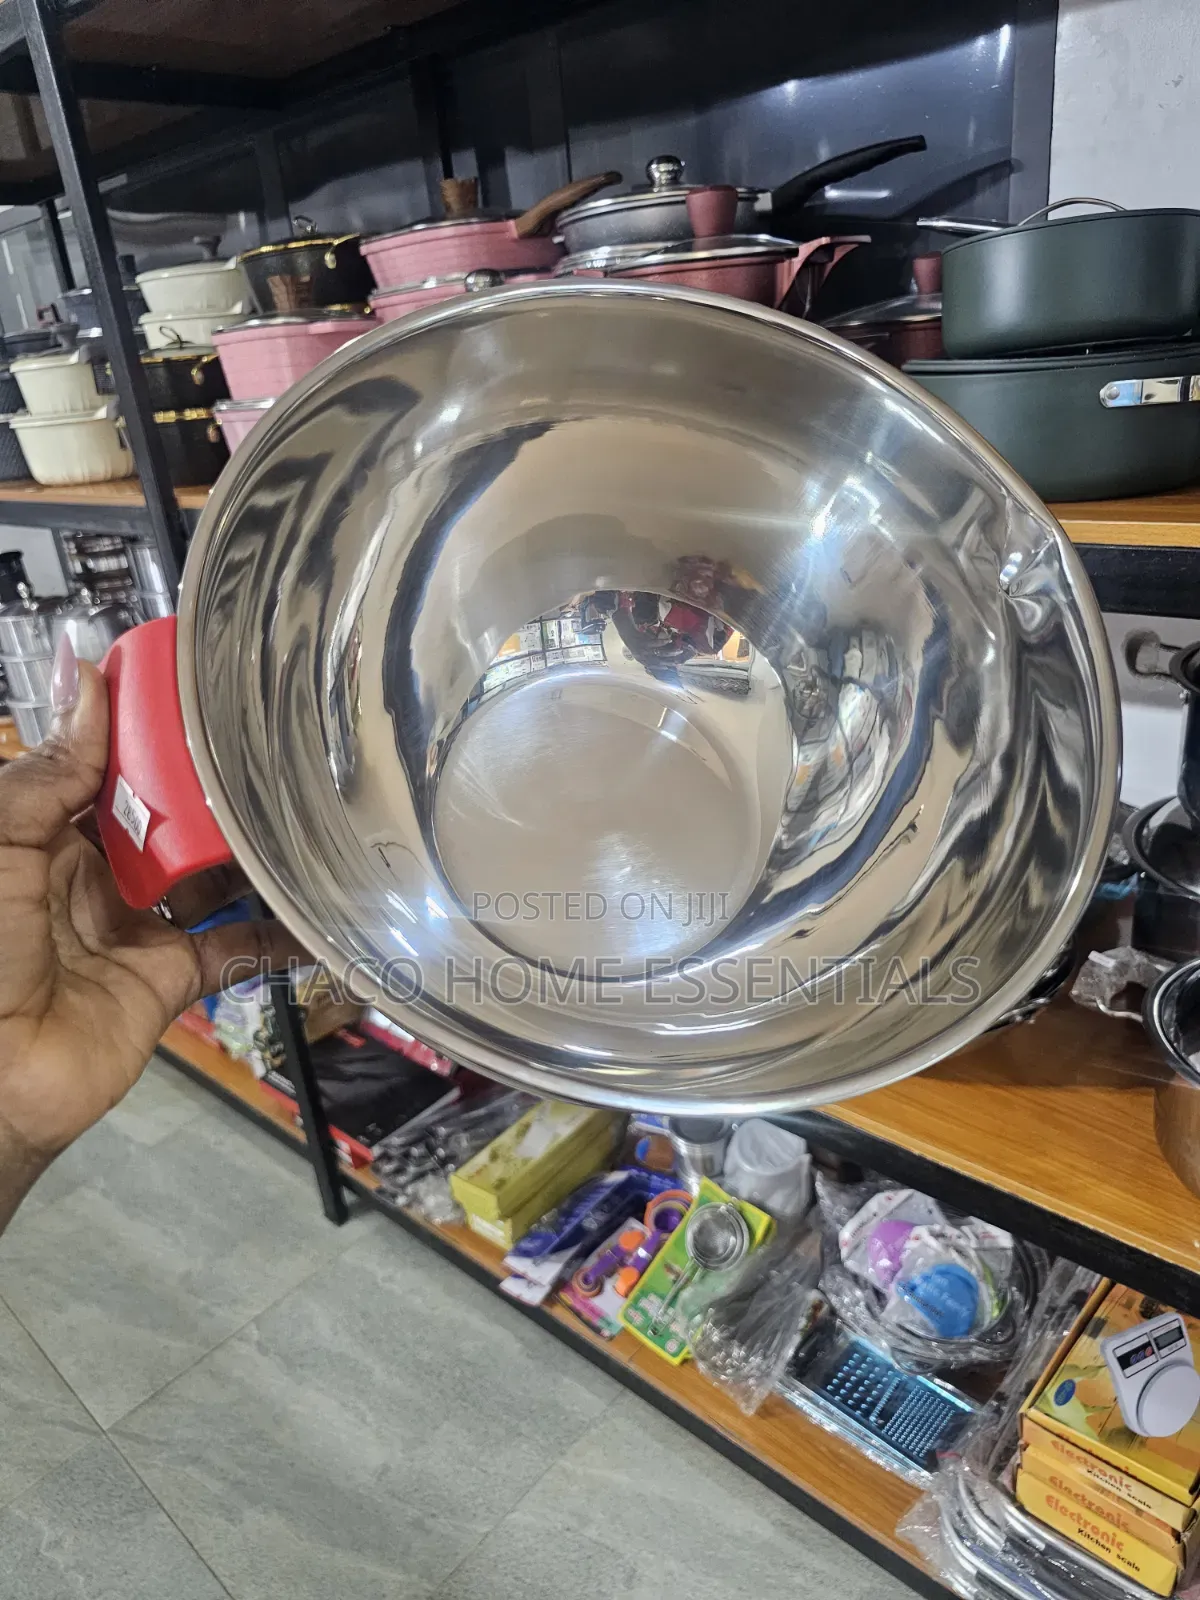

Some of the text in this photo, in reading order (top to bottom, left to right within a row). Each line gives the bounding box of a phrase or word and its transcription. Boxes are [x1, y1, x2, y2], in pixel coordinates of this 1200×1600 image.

[1050, 1439, 1133, 1492] Electronic
[1045, 1494, 1124, 1552] Electronic
[1048, 1475, 1129, 1529] Electronic
[1077, 1527, 1112, 1554] Kitchen
